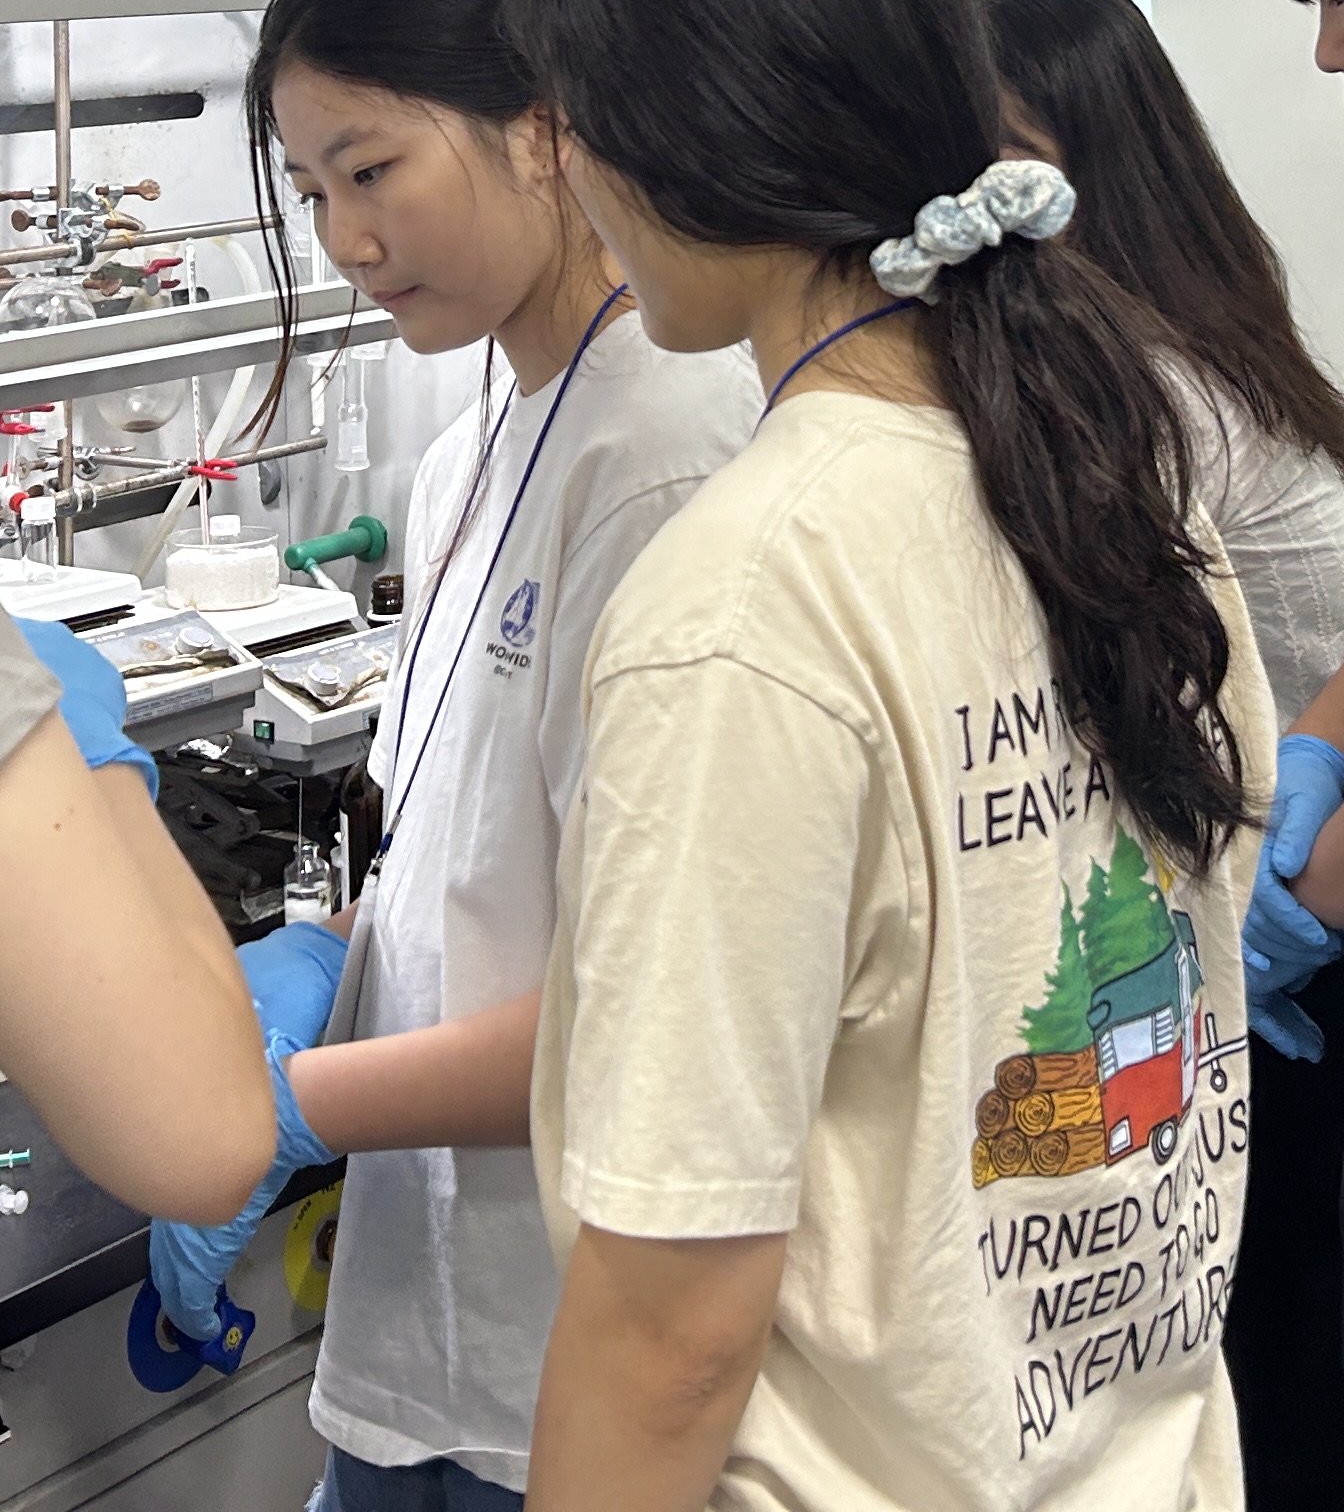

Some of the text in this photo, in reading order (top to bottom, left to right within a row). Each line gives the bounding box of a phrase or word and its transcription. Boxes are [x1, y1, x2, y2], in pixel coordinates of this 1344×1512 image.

[955, 704, 974, 771] I
[988, 686, 1050, 764] AM
[958, 762, 1076, 851] LEAVE
[978, 1196, 1142, 1297] TURNED
[1026, 1187, 1220, 1344] NEED TO GO
